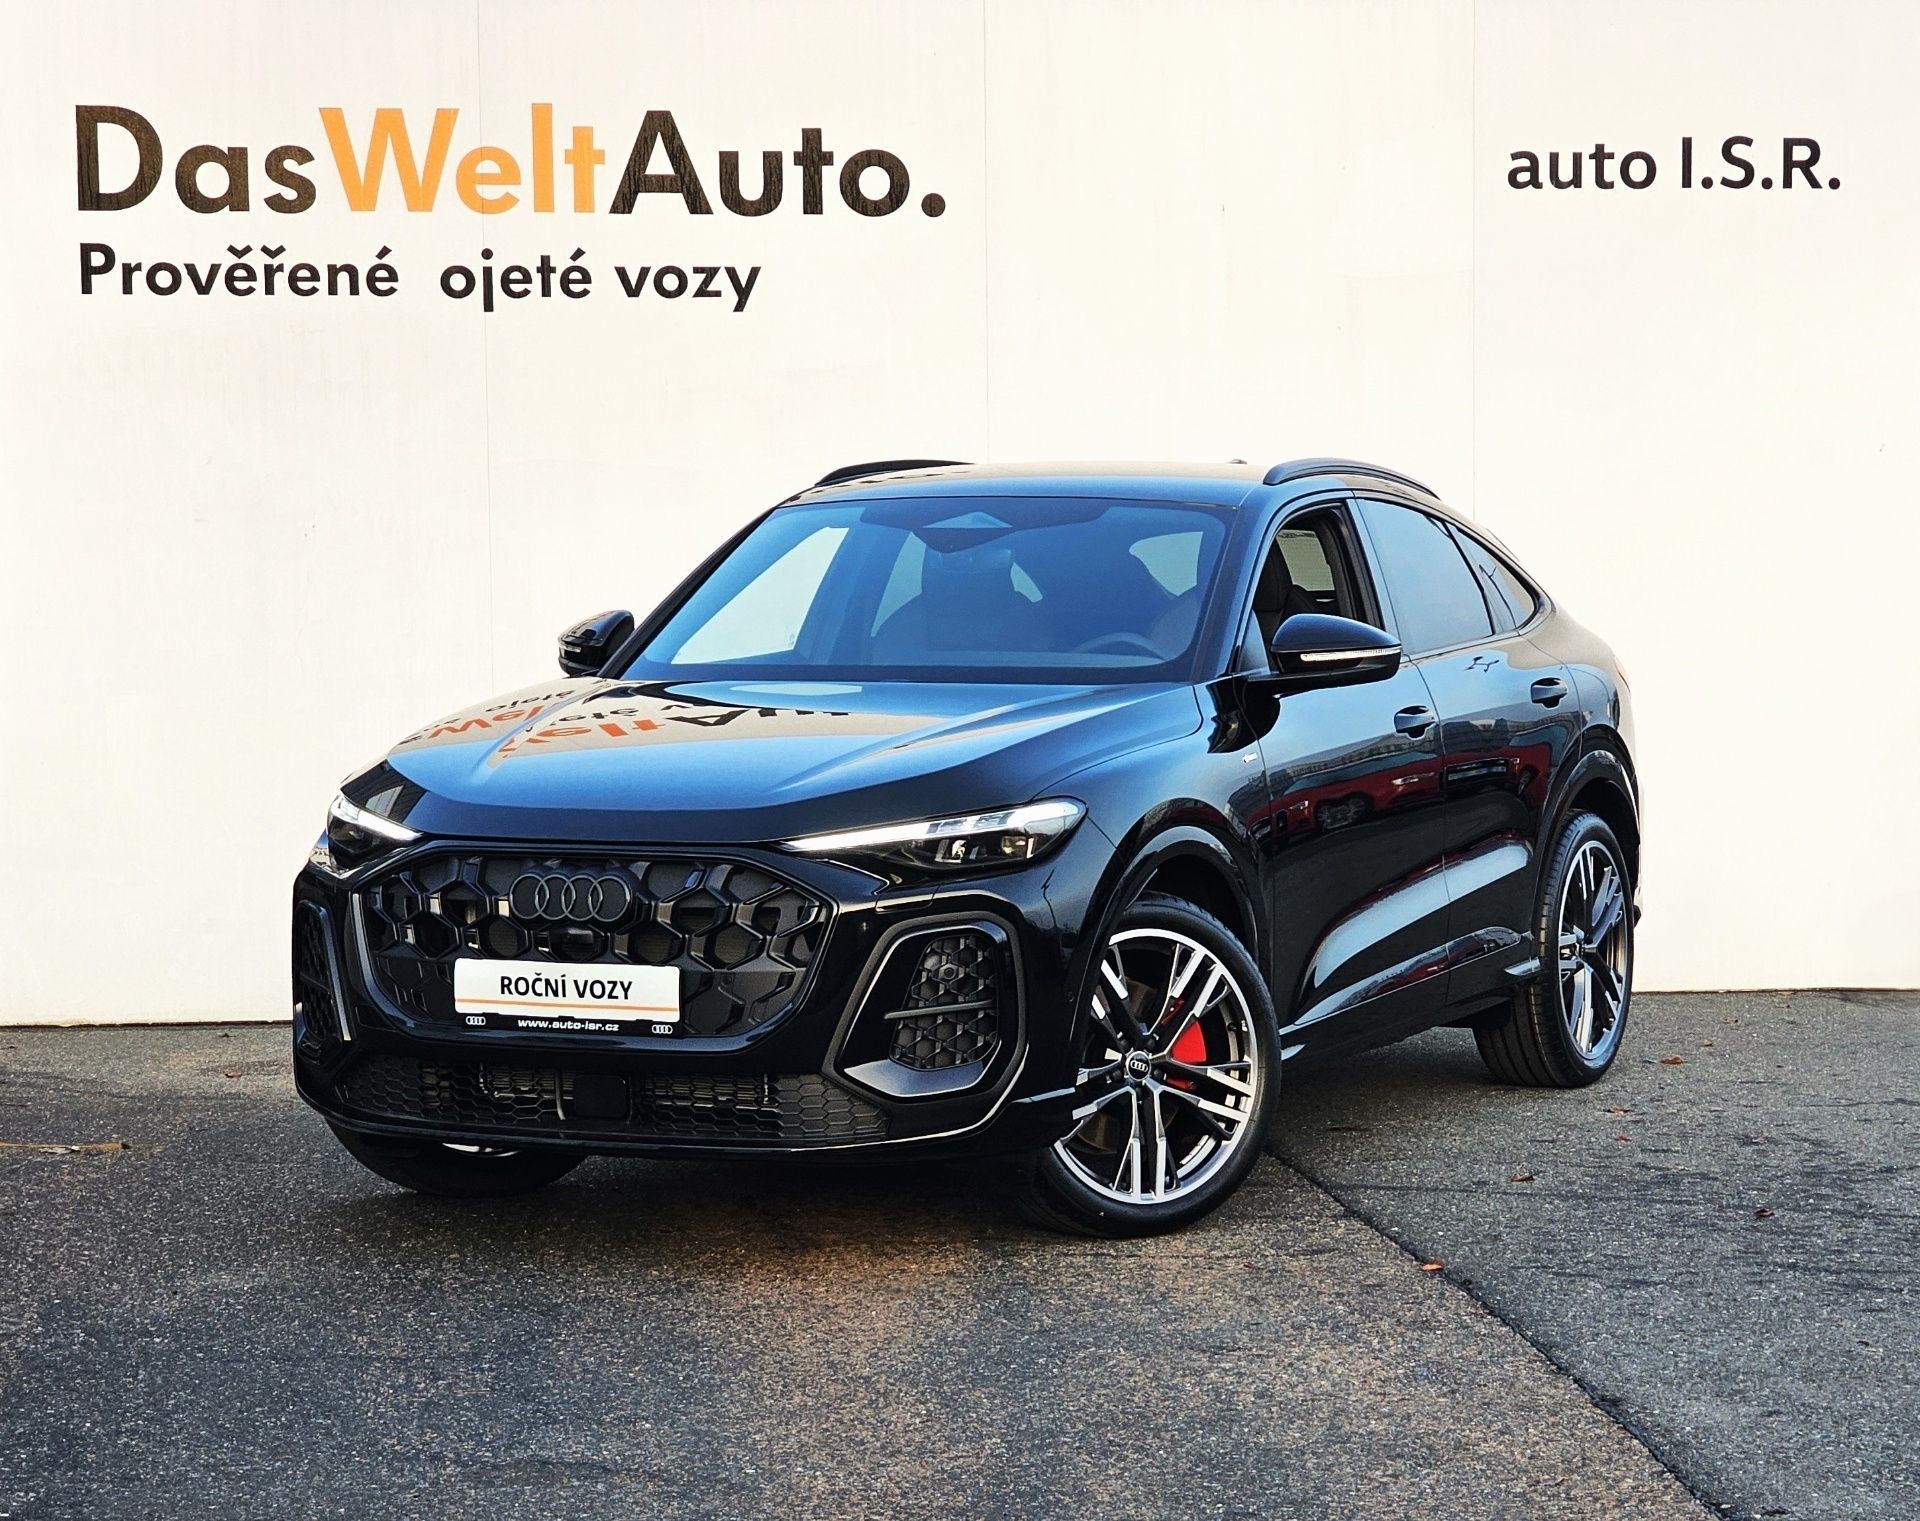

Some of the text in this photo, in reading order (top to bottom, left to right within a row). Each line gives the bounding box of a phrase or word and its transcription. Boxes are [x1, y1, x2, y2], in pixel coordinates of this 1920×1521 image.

[1507, 136, 1841, 190] auto I.S.R.
[80, 243, 762, 313] Prověřené ojeté vozy
[500, 972, 633, 1000] ROČNÍ VOZY
[517, 1018, 619, 1032] www.auto-isr.cz
